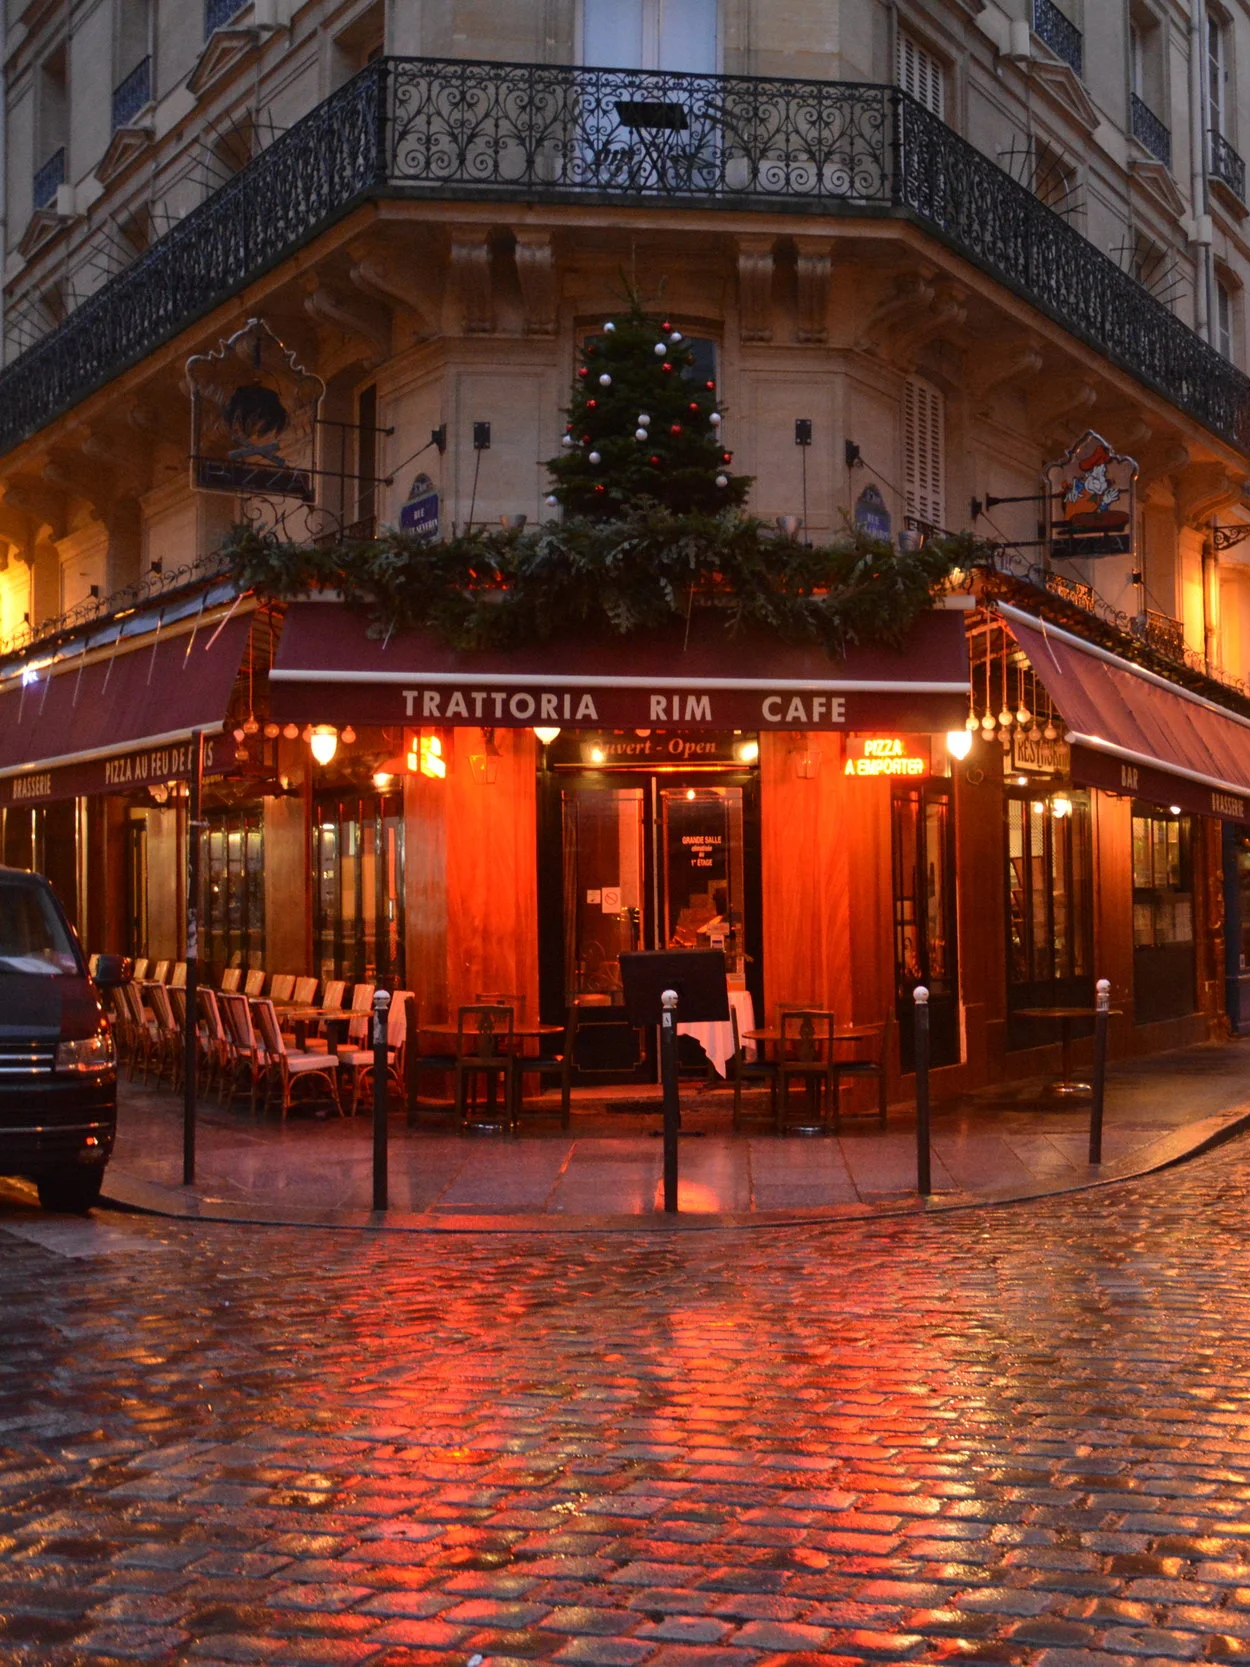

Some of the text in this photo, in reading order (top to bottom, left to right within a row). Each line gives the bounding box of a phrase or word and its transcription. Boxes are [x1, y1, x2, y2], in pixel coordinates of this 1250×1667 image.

[402, 690, 846, 723] TRATTORIA RIM CAFE
[668, 738, 717, 758] Open
[864, 739, 903, 757] PIZZA
[105, 741, 214, 785] PIZZA AU FEU DE BIS
[844, 758, 924, 776] A EMPORTER
[13, 773, 52, 799] BRASSERIE
[1121, 764, 1139, 790] BAR
[682, 836, 721, 845] GRANDE SALLE
